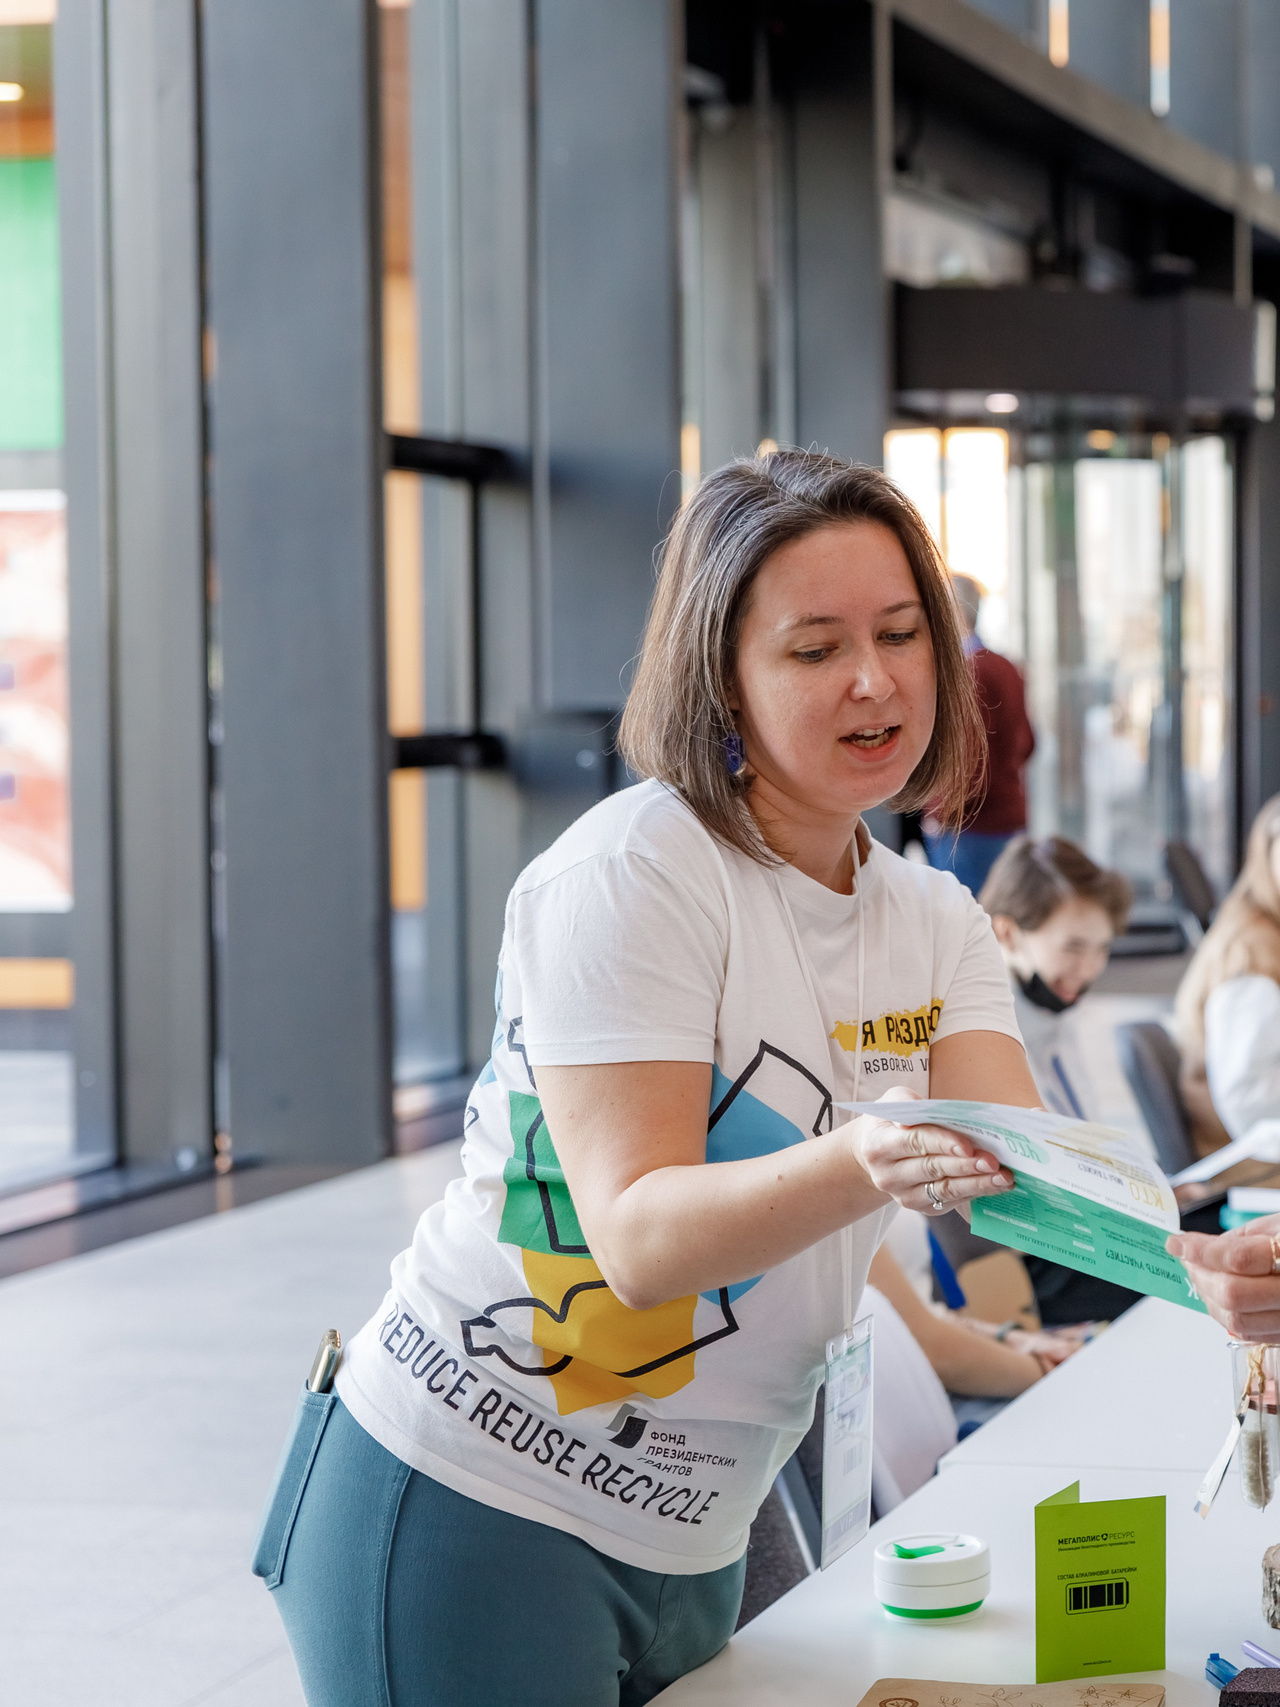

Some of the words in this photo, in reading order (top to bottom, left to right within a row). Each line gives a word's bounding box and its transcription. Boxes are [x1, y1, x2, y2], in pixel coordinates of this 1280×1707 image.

[862, 1019, 876, 1047] Я
[1128, 1181, 1165, 1211] КТО
[1105, 1248, 1145, 1271] УЧАСТИЕ?
[1146, 1263, 1182, 1284] ПРИНЯТЬ
[378, 1302, 479, 1411] REDUCE
[468, 1388, 587, 1477] REUSE
[582, 1452, 720, 1525] RECYCLE
[650, 1431, 686, 1446] ФОНД
[637, 1457, 693, 1476] ГРАНТОВ
[646, 1445, 738, 1468] ПРЕЗИДЕНТСКИХ
[1058, 1534, 1101, 1546] МЕГАПОЛИС
[1109, 1531, 1136, 1541] РЕСУРС
